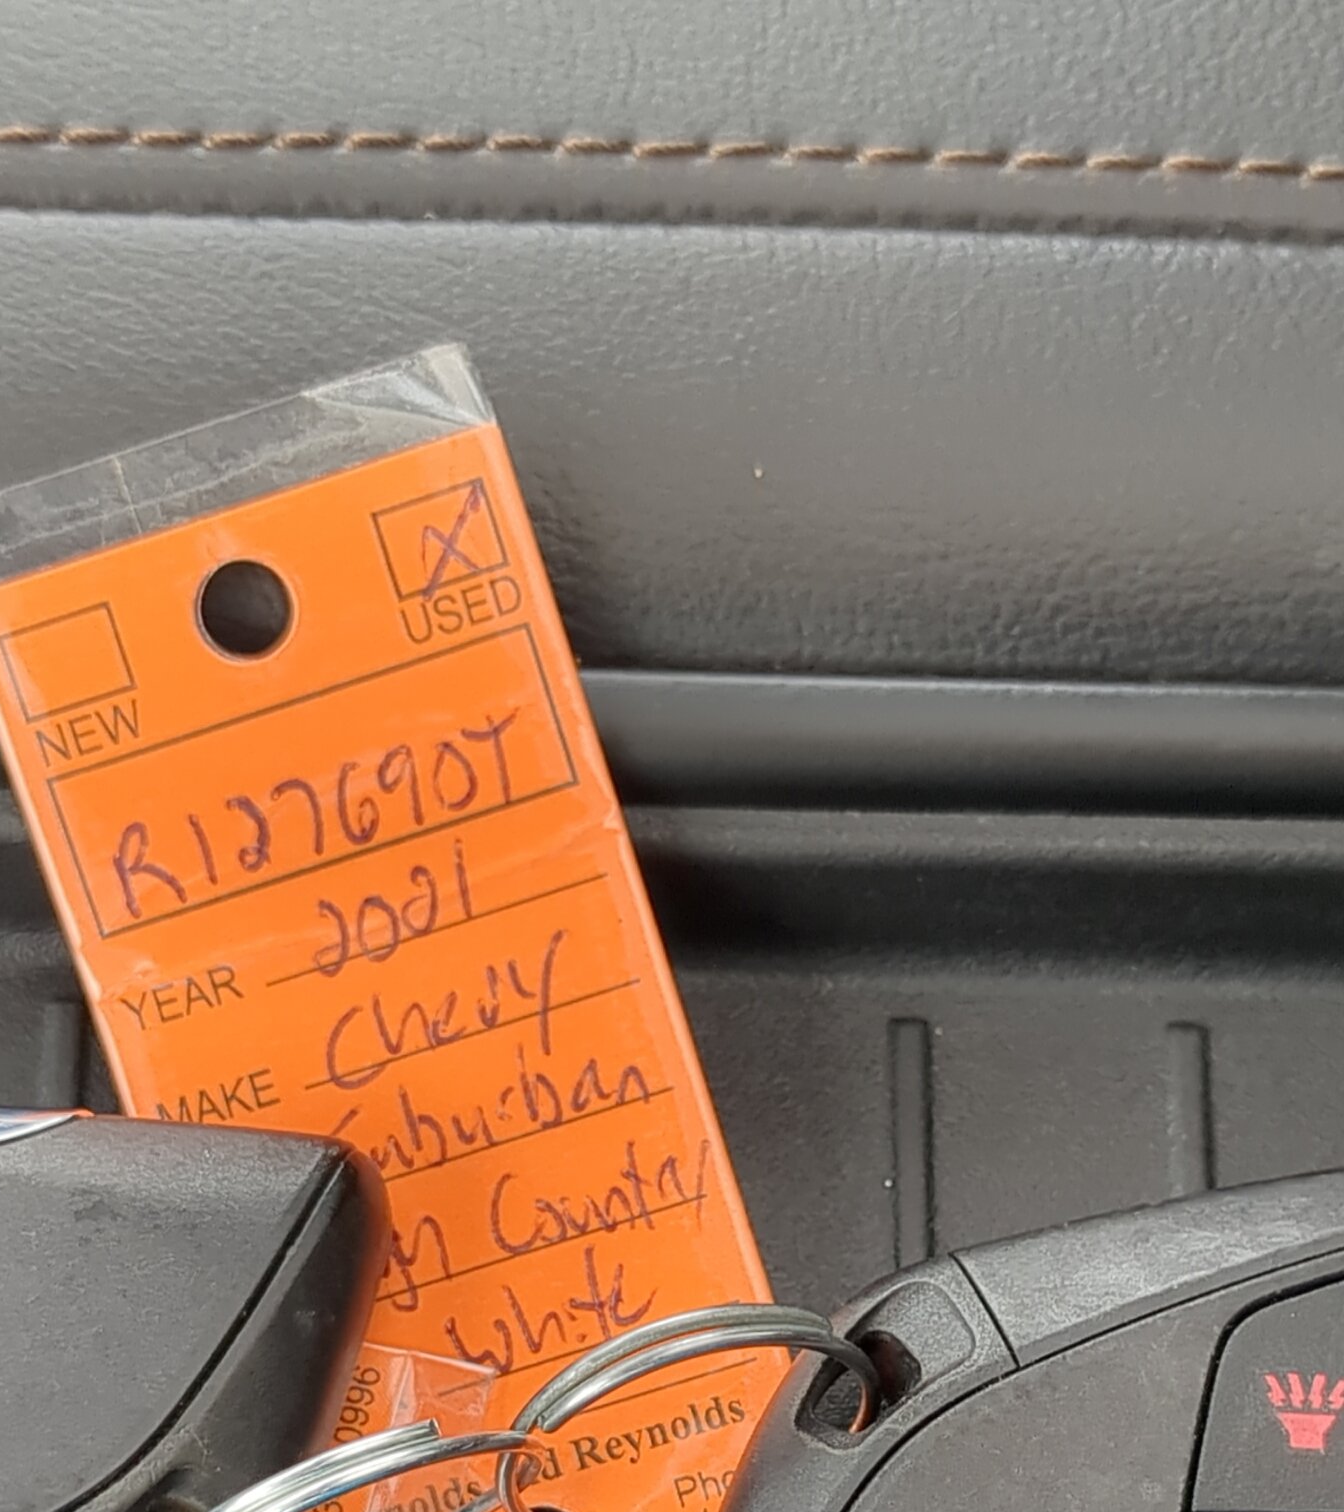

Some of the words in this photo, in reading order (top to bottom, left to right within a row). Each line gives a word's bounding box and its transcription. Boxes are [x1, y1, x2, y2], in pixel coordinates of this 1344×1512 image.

[400, 576, 522, 644] USED
[35, 700, 140, 768] NEW
[313, 838, 472, 977] 2021
[121, 965, 244, 1031] YEAR
[156, 1069, 281, 1122] MAKE
[330, 1042, 651, 1169] uburban
[568, 1396, 746, 1472] Reynolds
